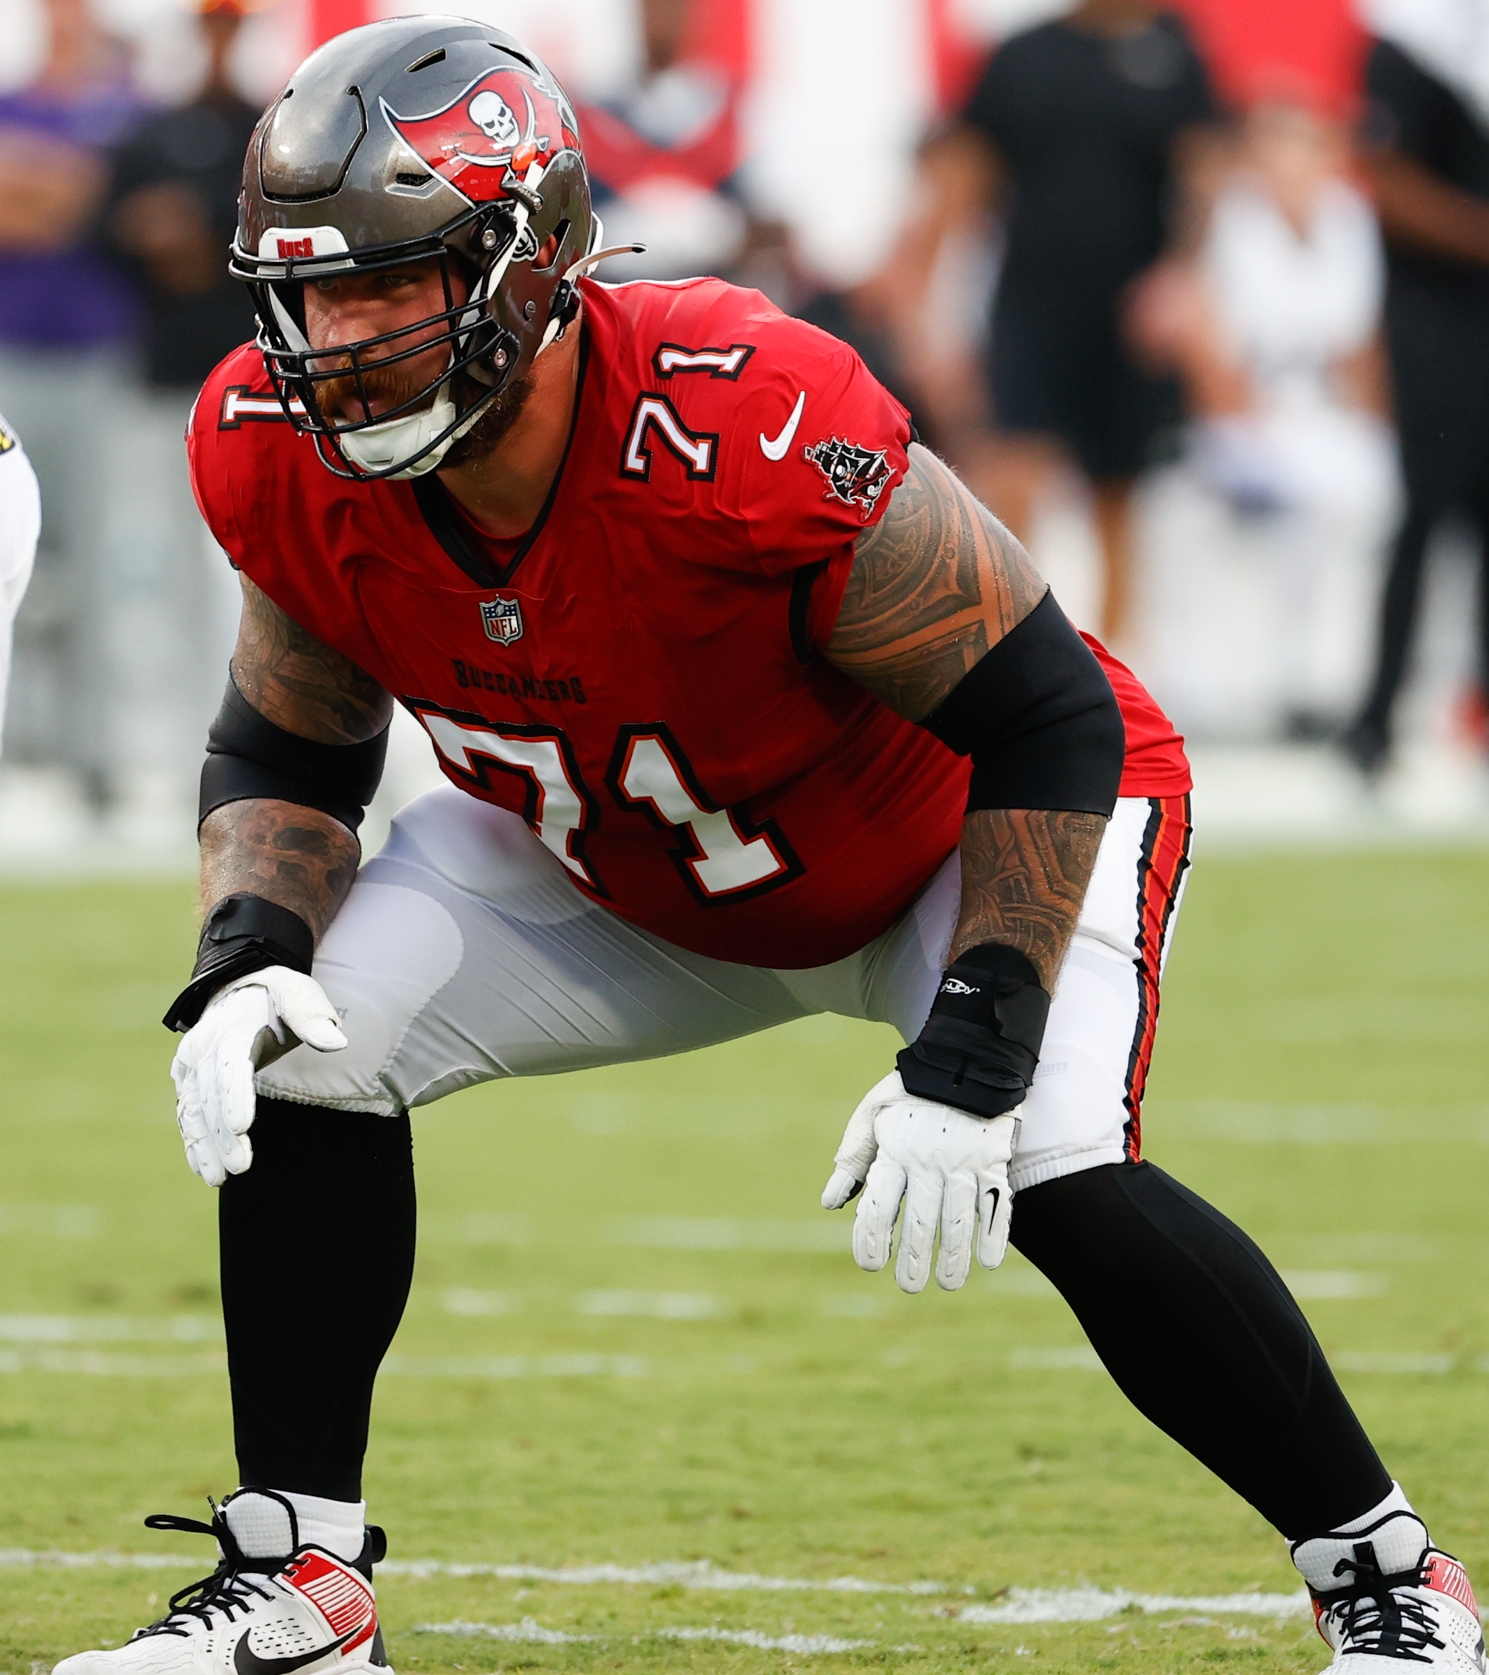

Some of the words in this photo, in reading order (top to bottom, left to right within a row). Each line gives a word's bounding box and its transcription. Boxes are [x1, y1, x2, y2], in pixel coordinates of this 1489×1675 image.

[218, 384, 312, 431] 1
[619, 341, 757, 483] 71
[488, 617, 519, 638] NFL
[400, 693, 808, 908] 71
